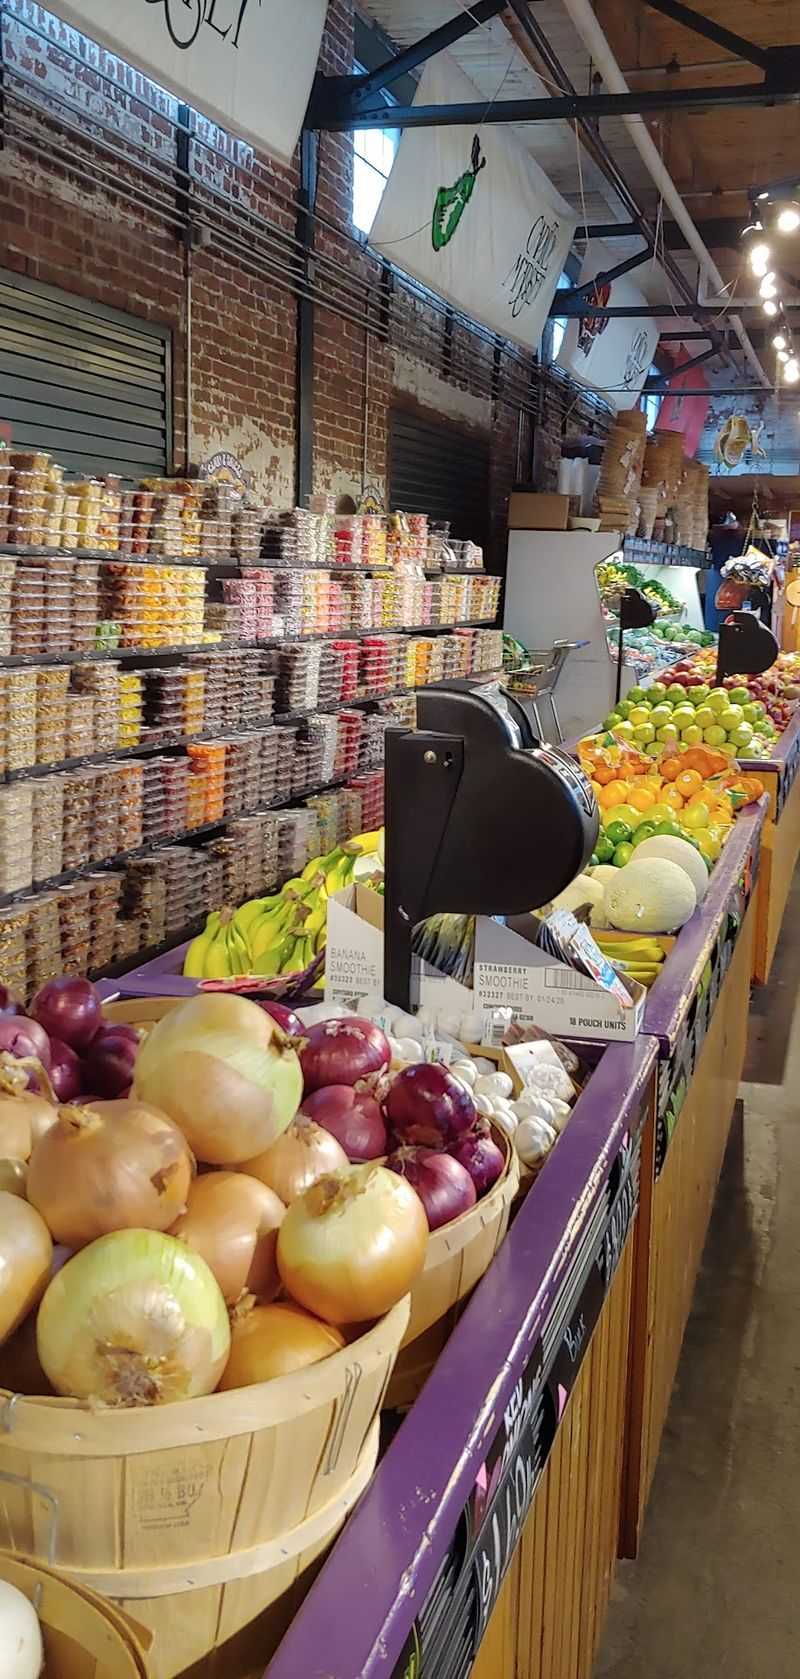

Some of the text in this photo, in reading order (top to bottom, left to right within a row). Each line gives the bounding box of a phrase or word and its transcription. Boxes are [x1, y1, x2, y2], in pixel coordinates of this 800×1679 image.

[331, 947, 366, 960] BANANA
[330, 961, 376, 977] SMOOTHIE
[479, 964, 527, 974] STRAWBERRY
[479, 974, 528, 990] SMOOTHIE
[569, 1017, 626, 1031] 18 POUCH UNITS
